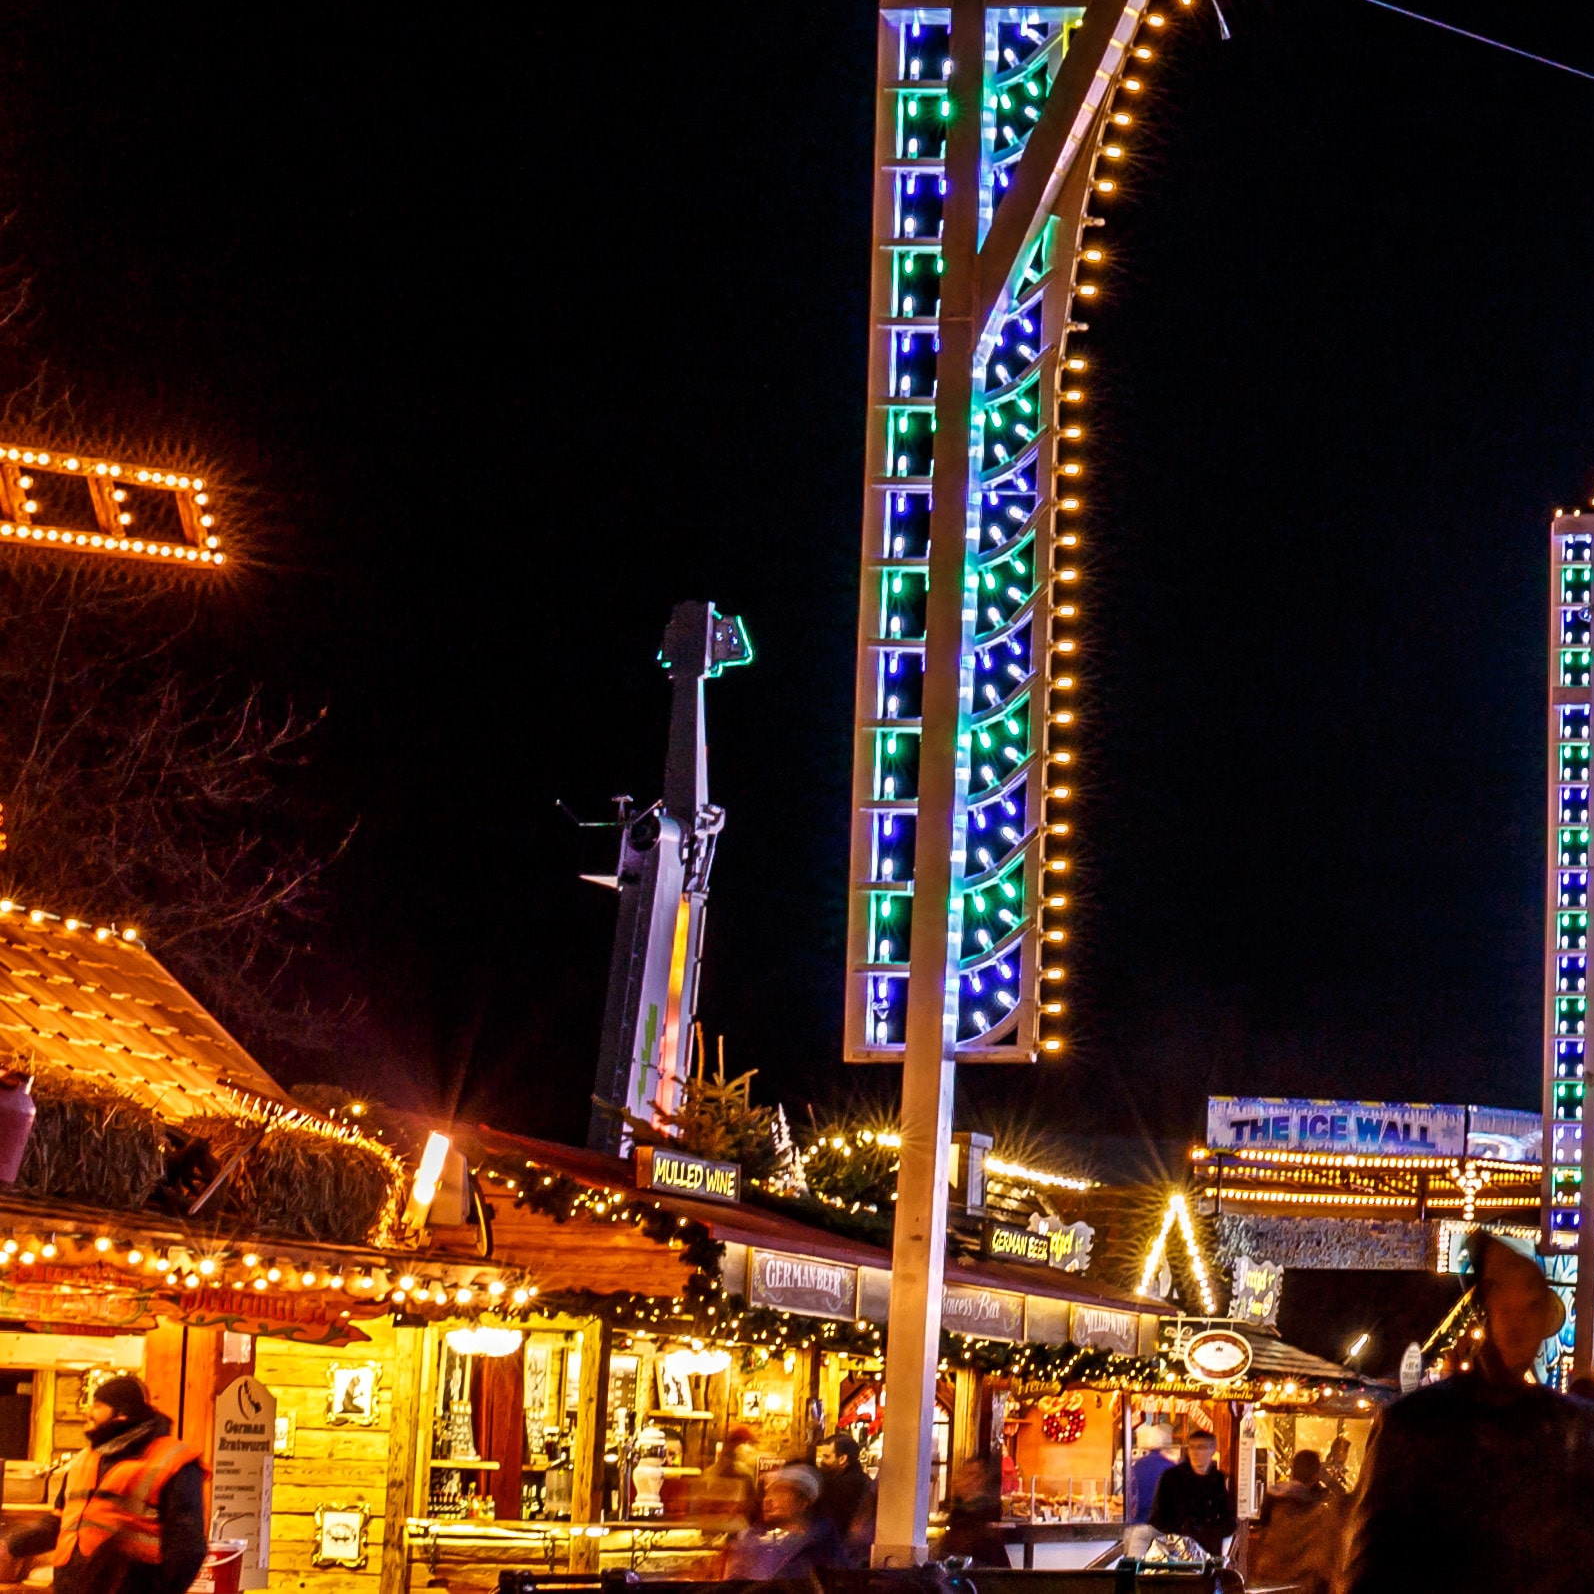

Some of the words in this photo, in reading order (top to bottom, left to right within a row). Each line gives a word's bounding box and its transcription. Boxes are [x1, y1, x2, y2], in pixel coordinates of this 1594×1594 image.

[1229, 1117, 1290, 1142] THE
[1300, 1114, 1347, 1142] ICE
[1355, 1115, 1436, 1149] WALL
[653, 1157, 703, 1190] MULLED
[705, 1168, 736, 1197] WINE
[991, 1228, 1028, 1256] GERMAN
[1027, 1236, 1048, 1261] BEER
